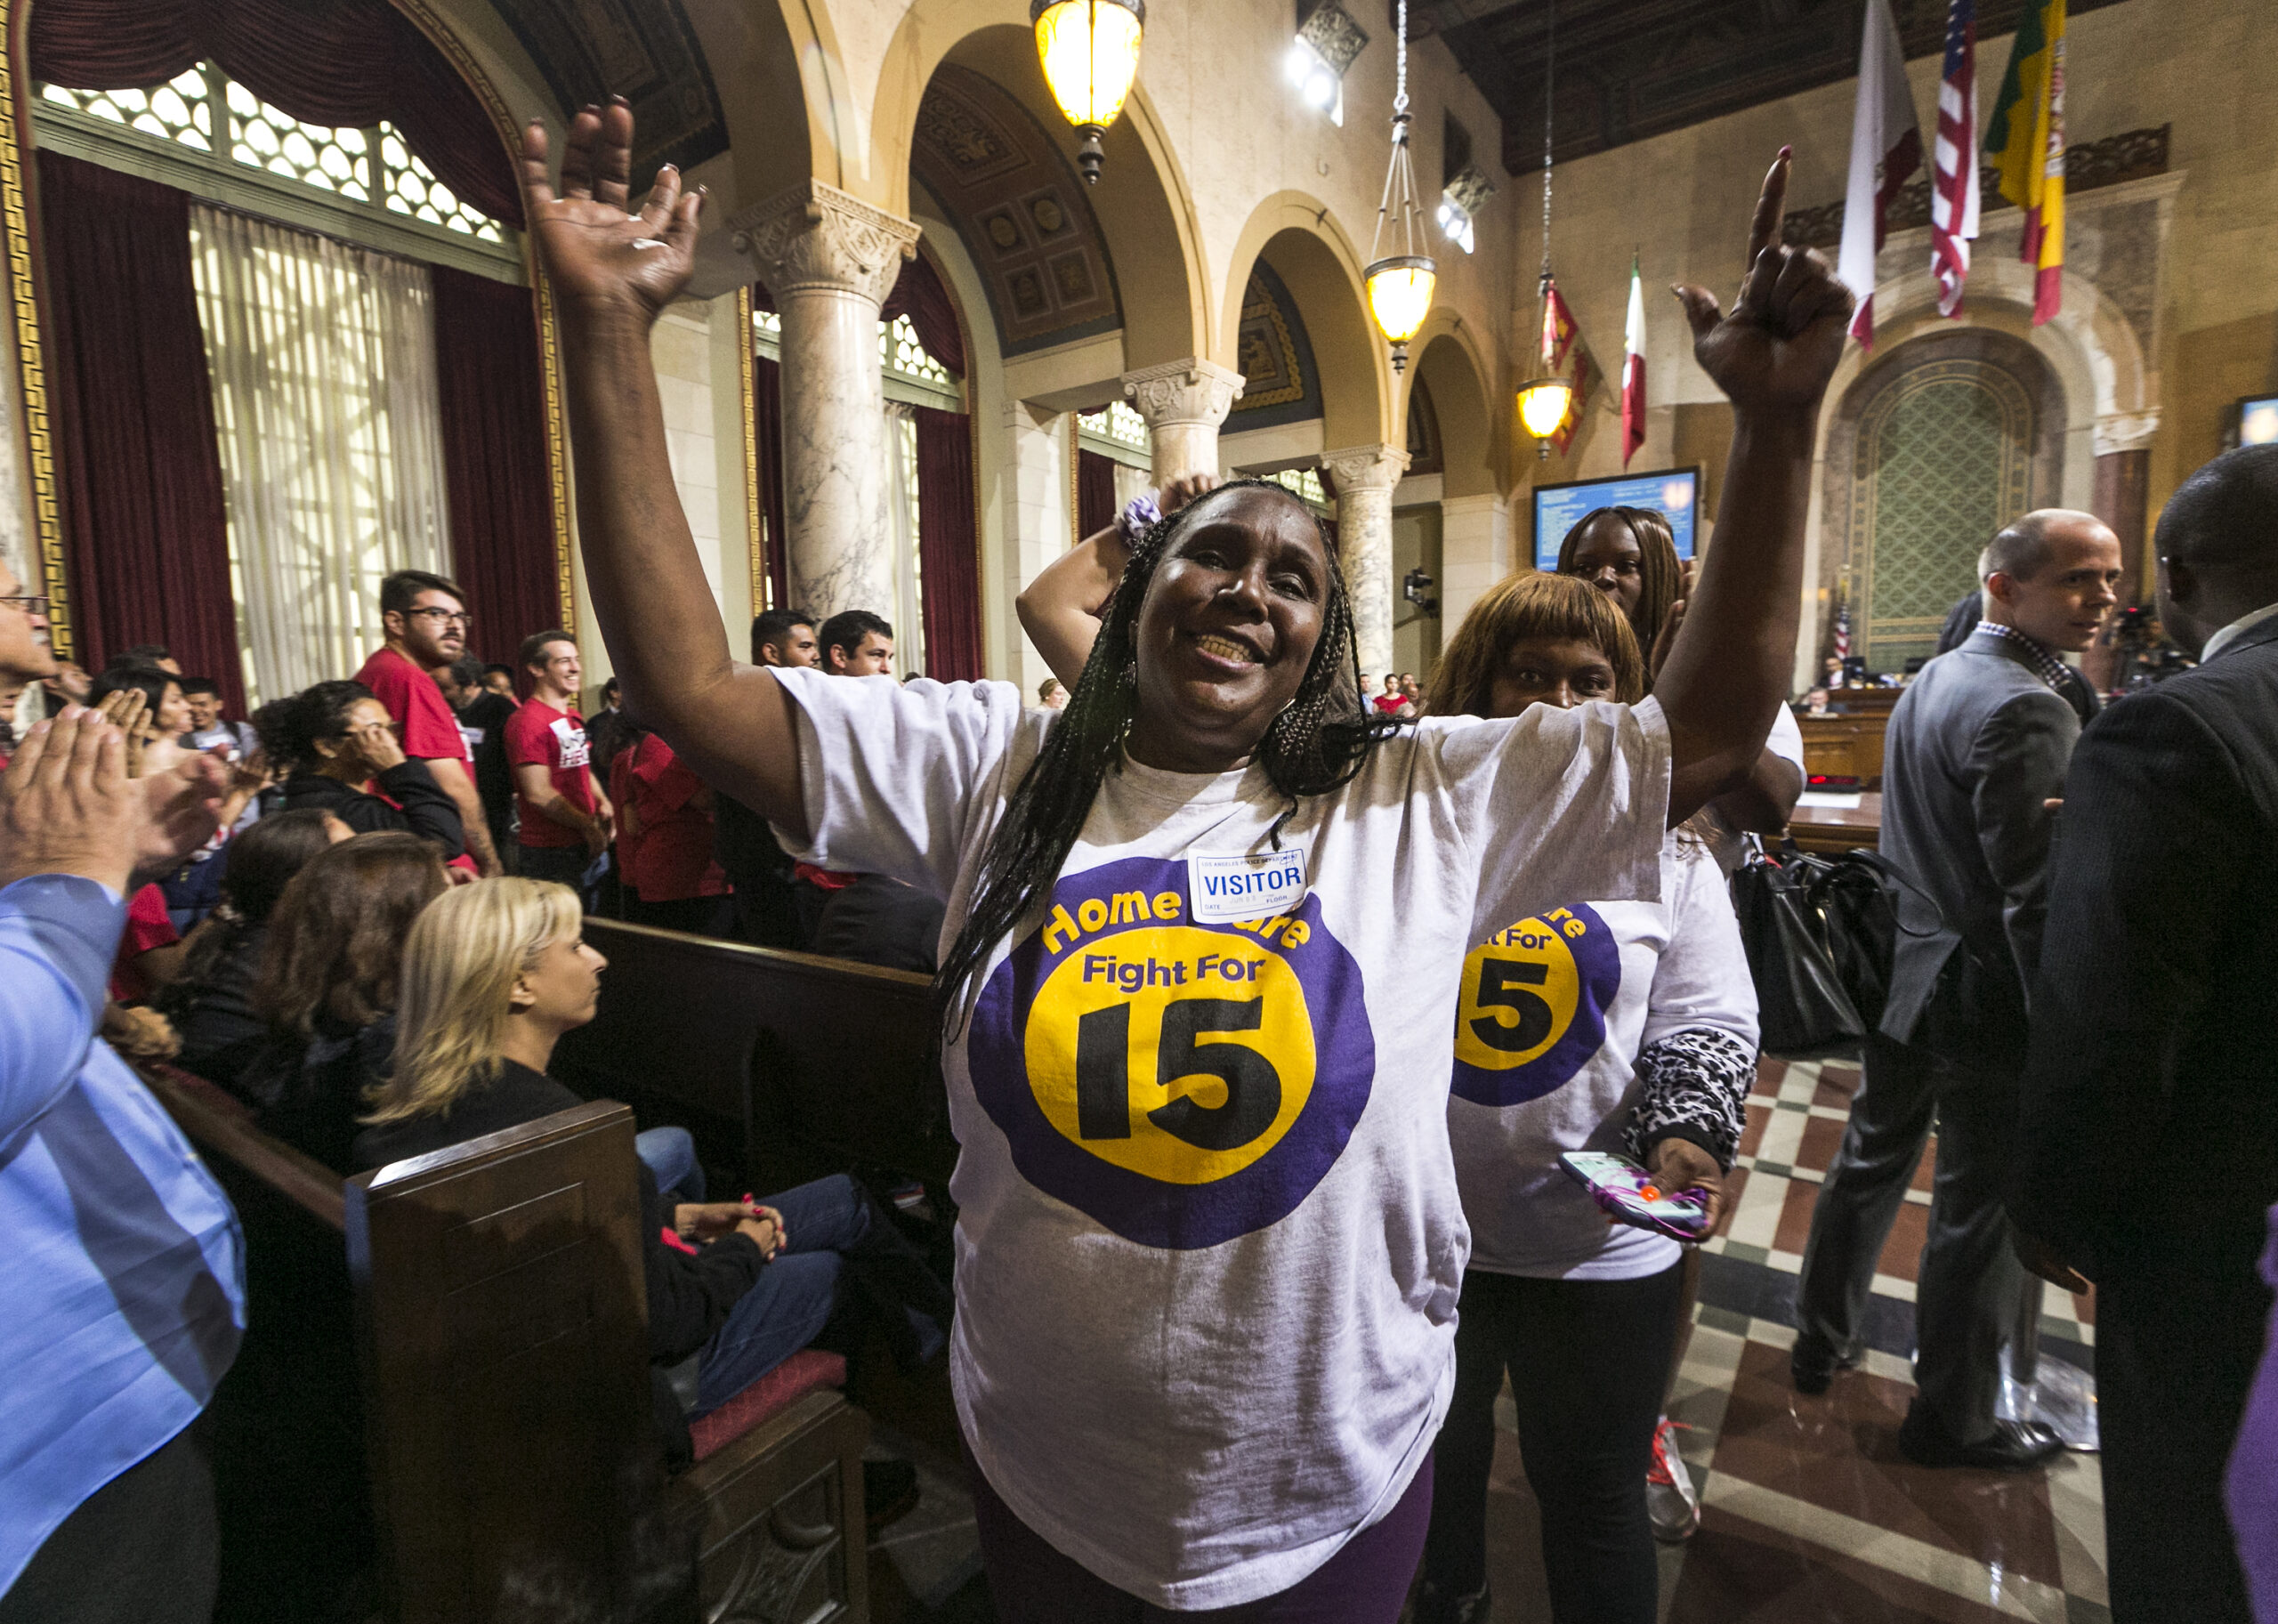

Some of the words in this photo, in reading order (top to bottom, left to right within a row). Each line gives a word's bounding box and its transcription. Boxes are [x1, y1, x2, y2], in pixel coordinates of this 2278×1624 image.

[1204, 867, 1301, 896] VISITOR
[1041, 890, 1183, 956] Home
[1232, 915, 1312, 949] are
[1506, 928, 1553, 950] For
[1082, 953, 1187, 994] Fight
[1197, 953, 1266, 983] For
[1076, 995, 1283, 1151] 15
